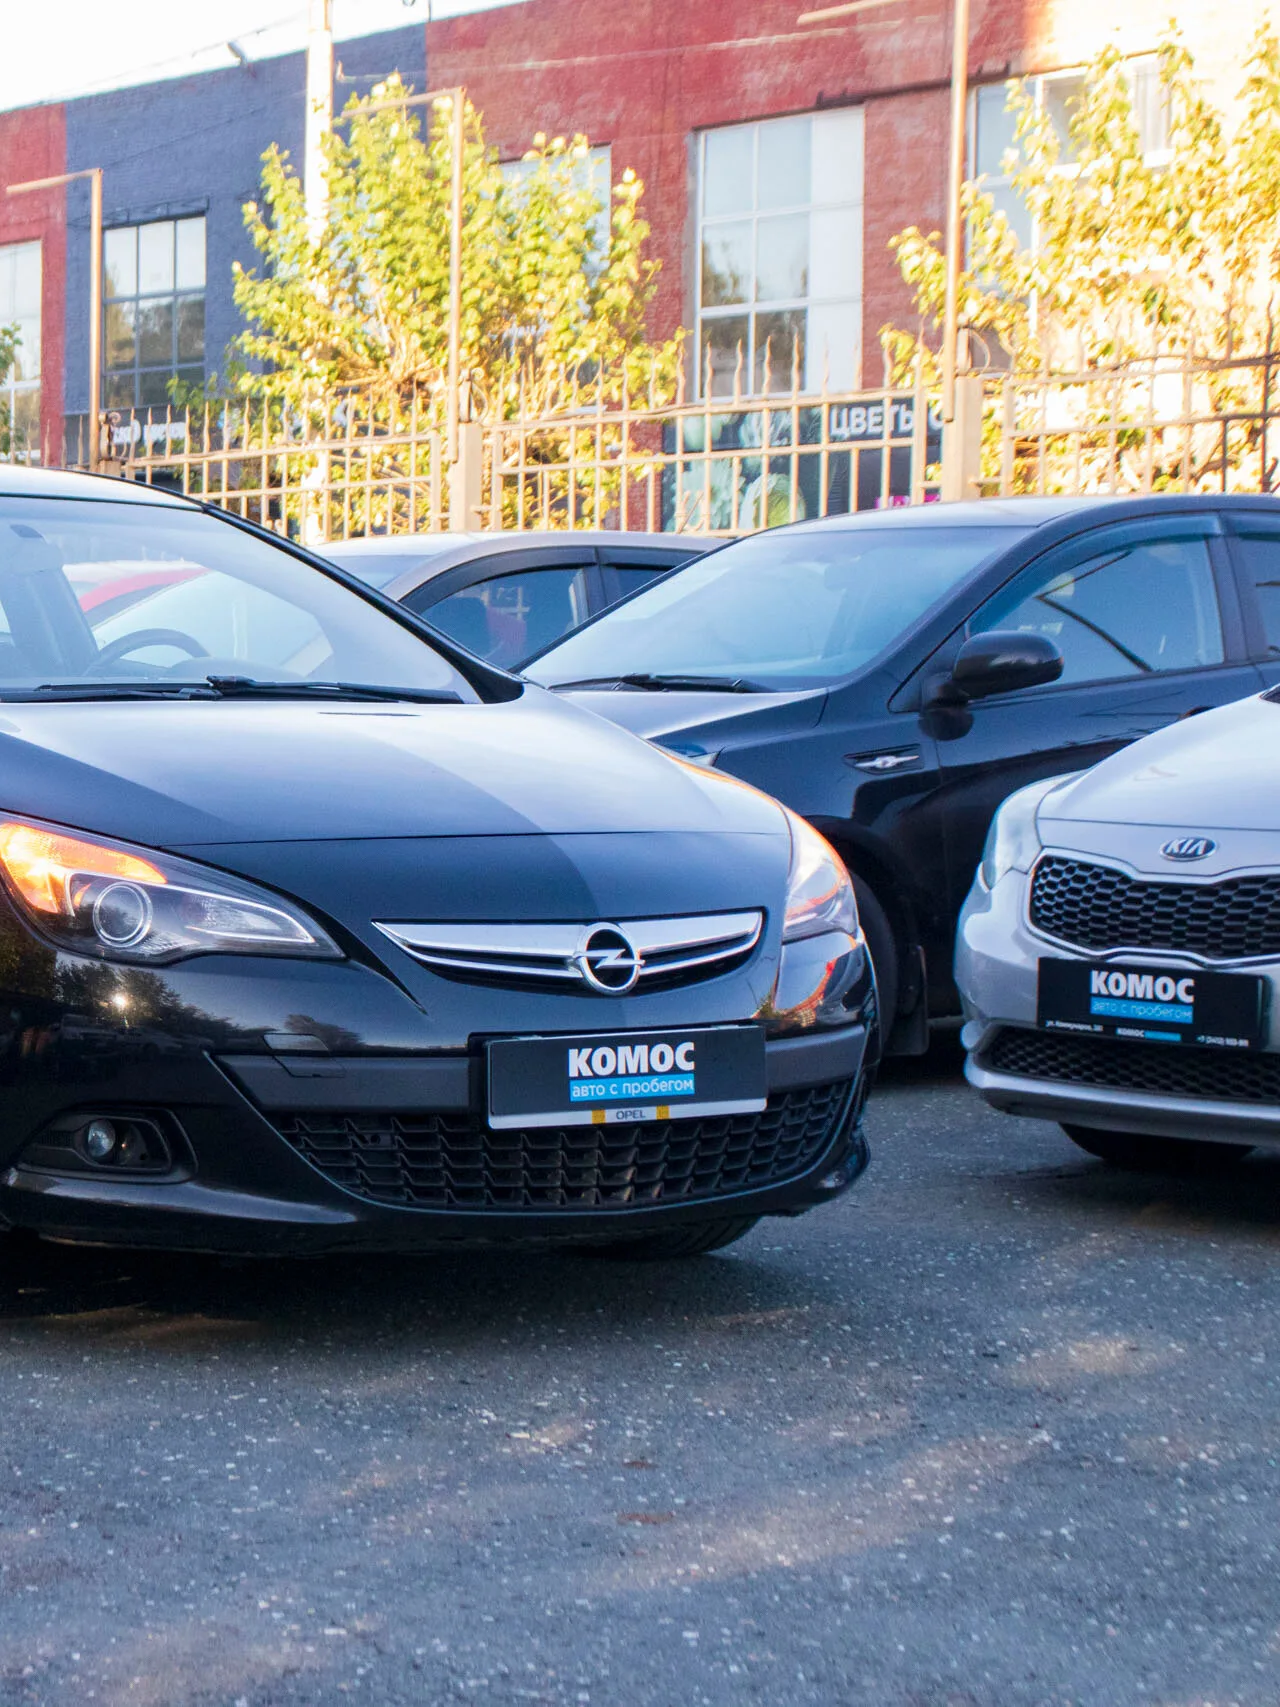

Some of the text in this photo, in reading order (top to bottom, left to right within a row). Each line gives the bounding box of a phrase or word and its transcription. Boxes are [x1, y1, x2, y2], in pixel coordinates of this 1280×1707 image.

[1165, 839, 1207, 856] KIA
[1090, 970, 1195, 1004] КОМОС
[569, 1042, 695, 1077] КОМОС
[572, 1078, 694, 1098] авто с пробегом
[616, 1109, 646, 1120] OPEL
